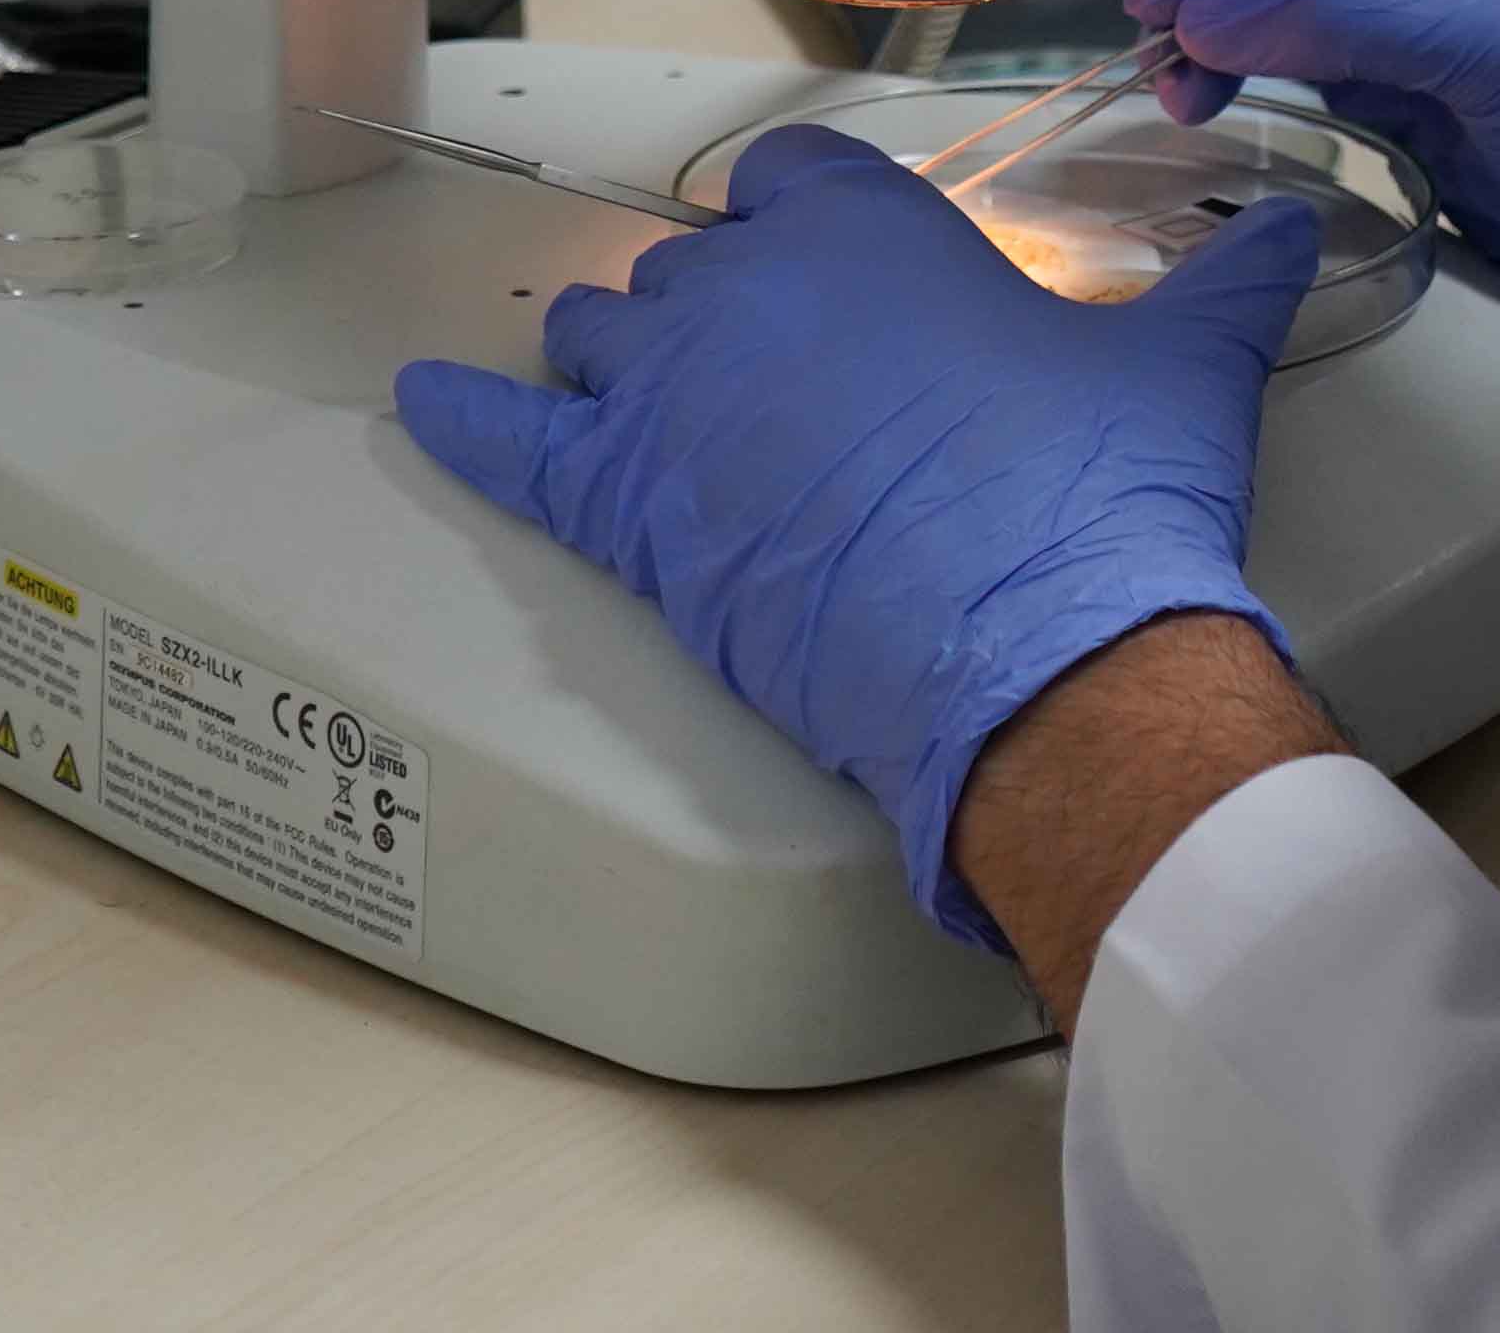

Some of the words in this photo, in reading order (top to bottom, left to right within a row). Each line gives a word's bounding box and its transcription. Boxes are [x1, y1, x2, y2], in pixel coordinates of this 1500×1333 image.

[6, 566, 76, 615] ACHTUNG
[109, 613, 152, 647] MODEL
[162, 635, 242, 688] SZX2-ILLK
[272, 692, 316, 749] CE
[369, 750, 407, 779] LISTED
[325, 818, 338, 832] EU
